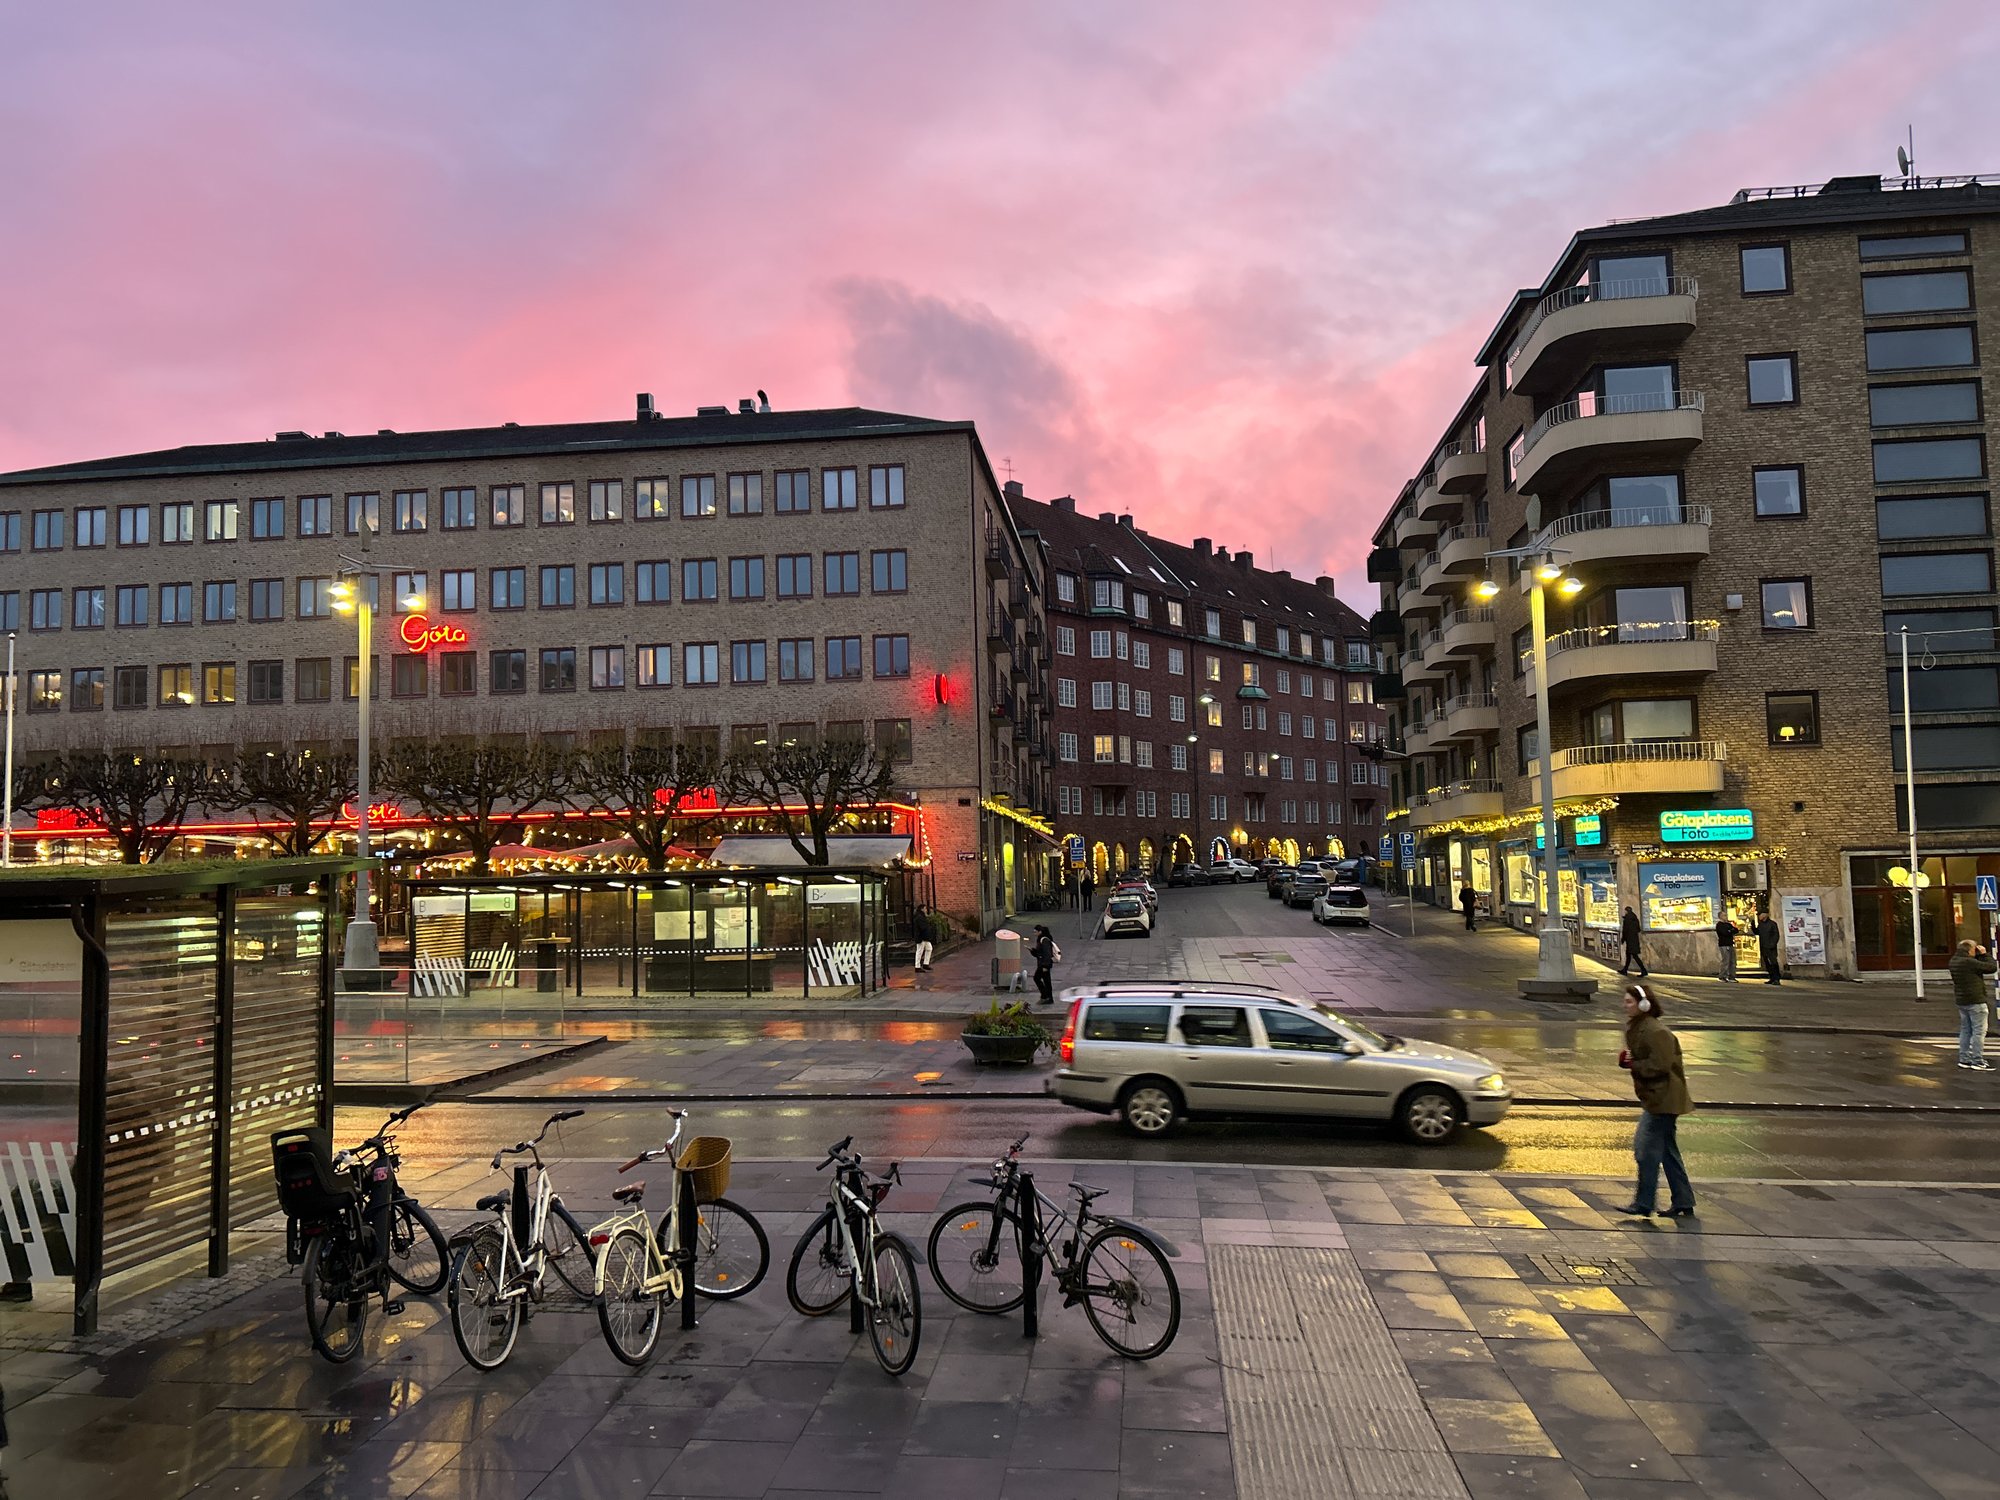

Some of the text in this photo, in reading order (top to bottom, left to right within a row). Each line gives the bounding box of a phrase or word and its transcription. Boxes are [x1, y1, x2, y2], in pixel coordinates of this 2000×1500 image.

[1661, 811, 1750, 829] Götaplatsens
[1404, 834, 1411, 843] P
[1681, 828, 1710, 840] Foto
[1075, 839, 1081, 847] P
[1653, 873, 1705, 883] Götaplatsens
